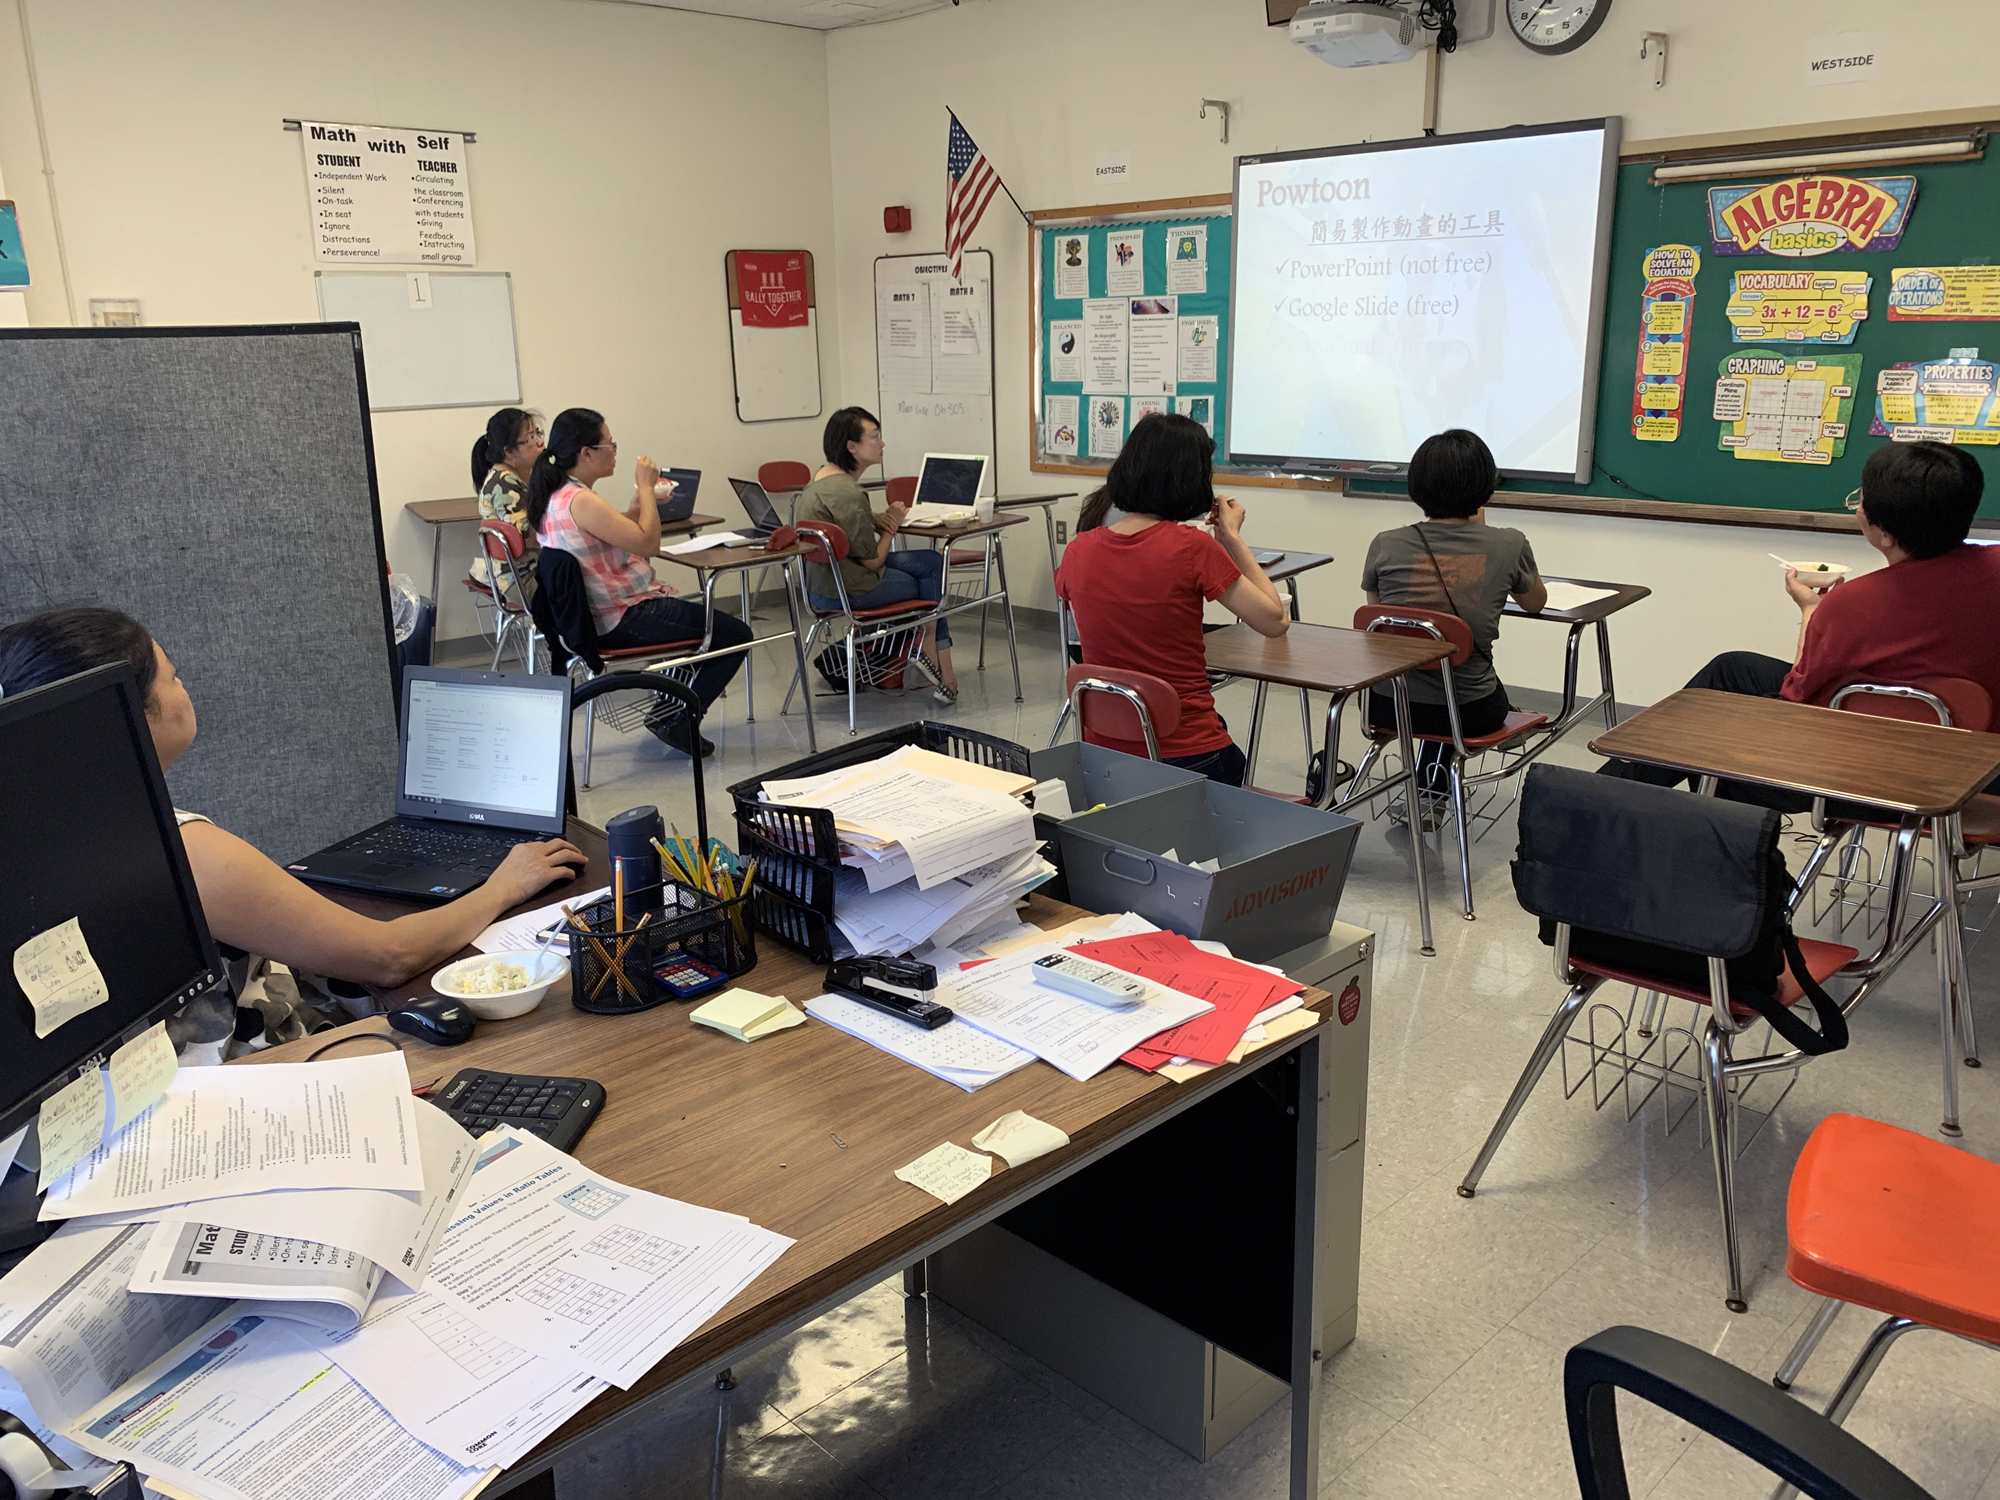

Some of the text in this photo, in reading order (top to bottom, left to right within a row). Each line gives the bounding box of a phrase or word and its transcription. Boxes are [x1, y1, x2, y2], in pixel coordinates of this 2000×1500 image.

[1562, 21, 1570, 29] 5
[1812, 55, 1874, 71] WESTSIDE
[311, 127, 449, 154] Math with Self
[317, 154, 361, 168] STUDENT
[417, 160, 458, 173] TEACHER
[1096, 165, 1127, 176] EASTSIDE
[319, 172, 387, 182] Independent Work
[415, 176, 454, 186] Circulating
[322, 187, 344, 195] Silent
[414, 188, 464, 197] the classroom
[1257, 177, 1371, 208] Powtoon
[322, 197, 354, 205] On-task
[417, 197, 464, 208] Conferencing
[324, 210, 334, 218] In
[415, 210, 464, 219] with students
[1732, 180, 1893, 244] ALGEBRA
[324, 223, 350, 232] Ignore
[421, 219, 443, 229] Giving
[1311, 210, 1506, 244] 簡易製作動畫的工具
[419, 231, 454, 240] Feedback
[1109, 233, 1142, 242] PRINCIPLED
[1171, 229, 1204, 238] THINKERS
[1769, 227, 1838, 250] basics
[322, 235, 370, 244] Distractions
[423, 241, 464, 250] Instructing
[327, 249, 380, 257] Perseverance!
[421, 253, 461, 262] small group
[1654, 249, 1691, 260] HOW TO
[1290, 251, 1493, 279] PowerPoint (not free)
[1651, 258, 1693, 269] SOLVE AN
[915, 265, 948, 274] OBJECTIVES
[1649, 267, 1693, 278] EQUATION
[1740, 273, 1814, 290] VOCABULARY
[1899, 275, 1942, 291] ORDER OF
[414, 278, 426, 302] 1
[950, 286, 974, 297] MATH 8
[745, 290, 802, 304] RALLY TOGETHER
[893, 294, 911, 302] MATH
[1889, 291, 1945, 307] OPERATIONS
[1289, 294, 1460, 322] Google Slide (free)
[1762, 305, 1777, 318] 3x
[1796, 305, 1811, 318] 12
[1053, 323, 1082, 331] BALANCED
[1728, 359, 1785, 375] GRAPHING
[1924, 365, 1993, 380] PROPERTIES
[1224, 863, 1331, 922] ADVISORY
[444, 1077, 470, 1101] Microsoft
[473, 1198, 504, 1213] Values
[502, 1189, 514, 1199] in
[513, 1181, 535, 1193] Ratio
[535, 1166, 562, 1180] Tables
[563, 1185, 586, 1198] Example
[402, 1247, 412, 1263] EUREKA
[406, 1254, 414, 1266] MATH
[456, 1287, 469, 1296] Step
[466, 1431, 497, 1452] COMMON
[469, 1440, 487, 1453] CORE
